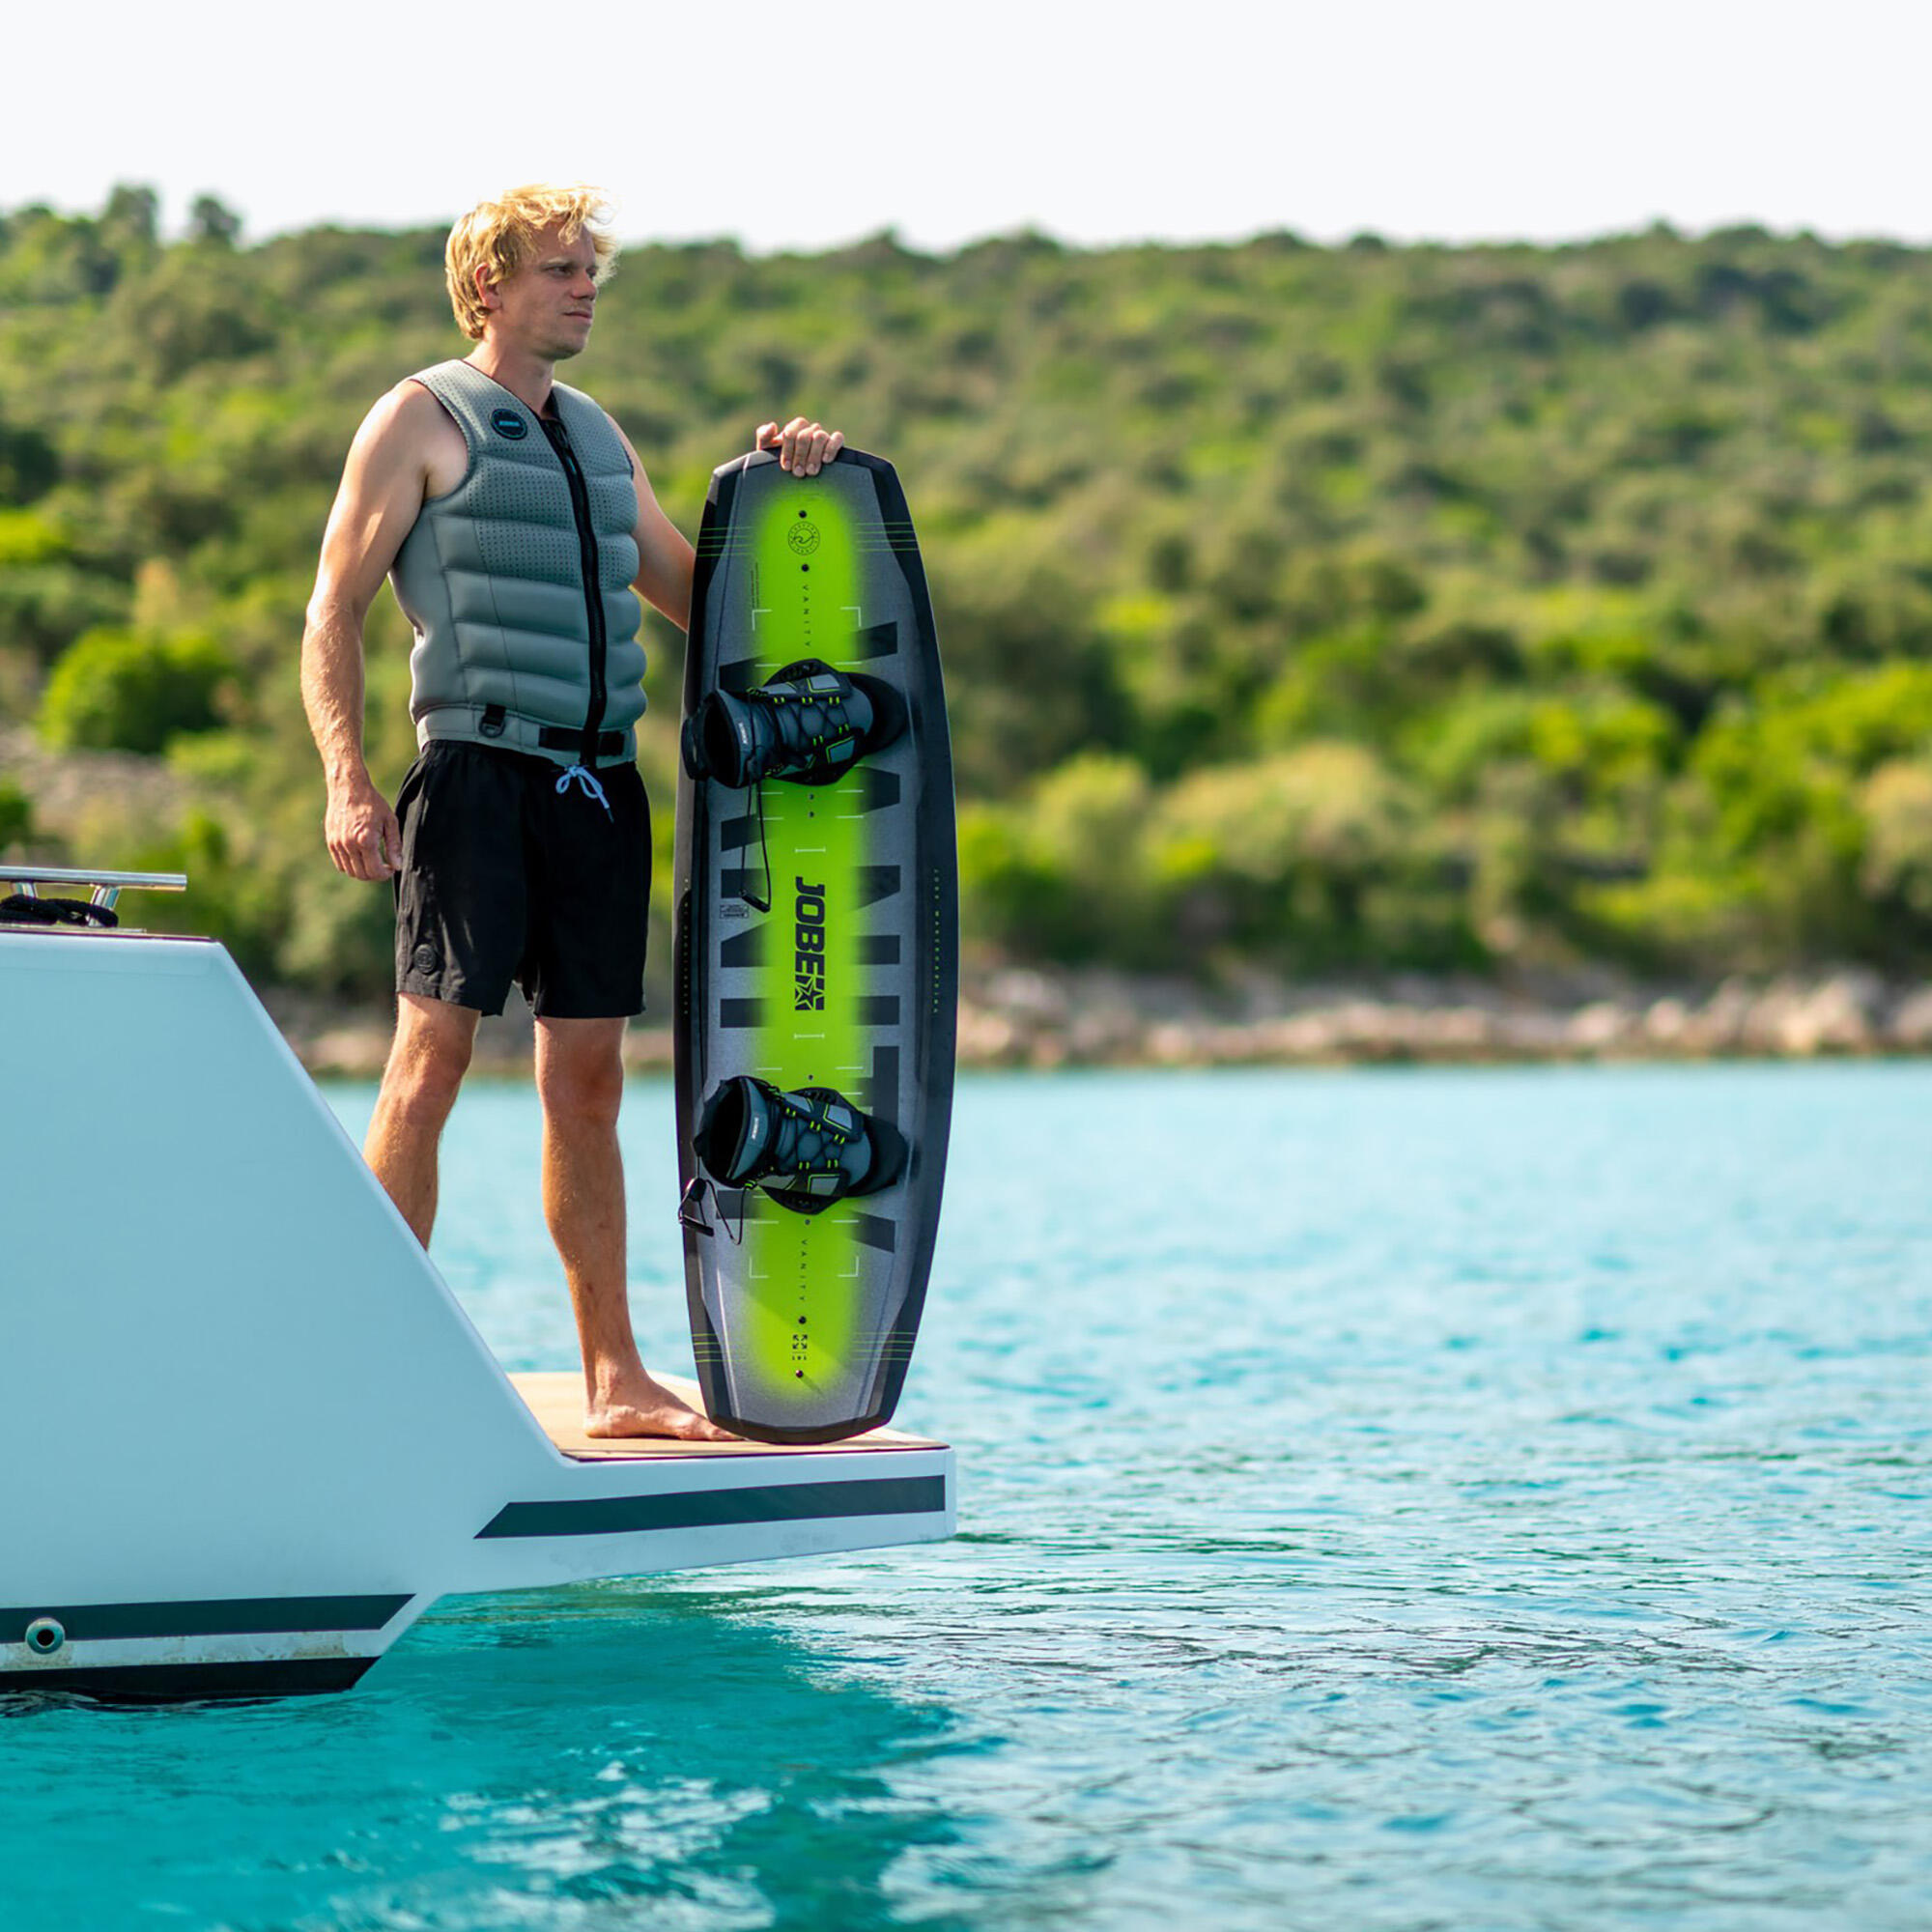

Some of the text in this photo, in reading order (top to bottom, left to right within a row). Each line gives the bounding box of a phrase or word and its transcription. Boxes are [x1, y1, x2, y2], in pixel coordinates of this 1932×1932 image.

[803, 583, 811, 648] VANITY
[795, 875, 825, 978] JOBE
[799, 1238, 809, 1302] VANITY
